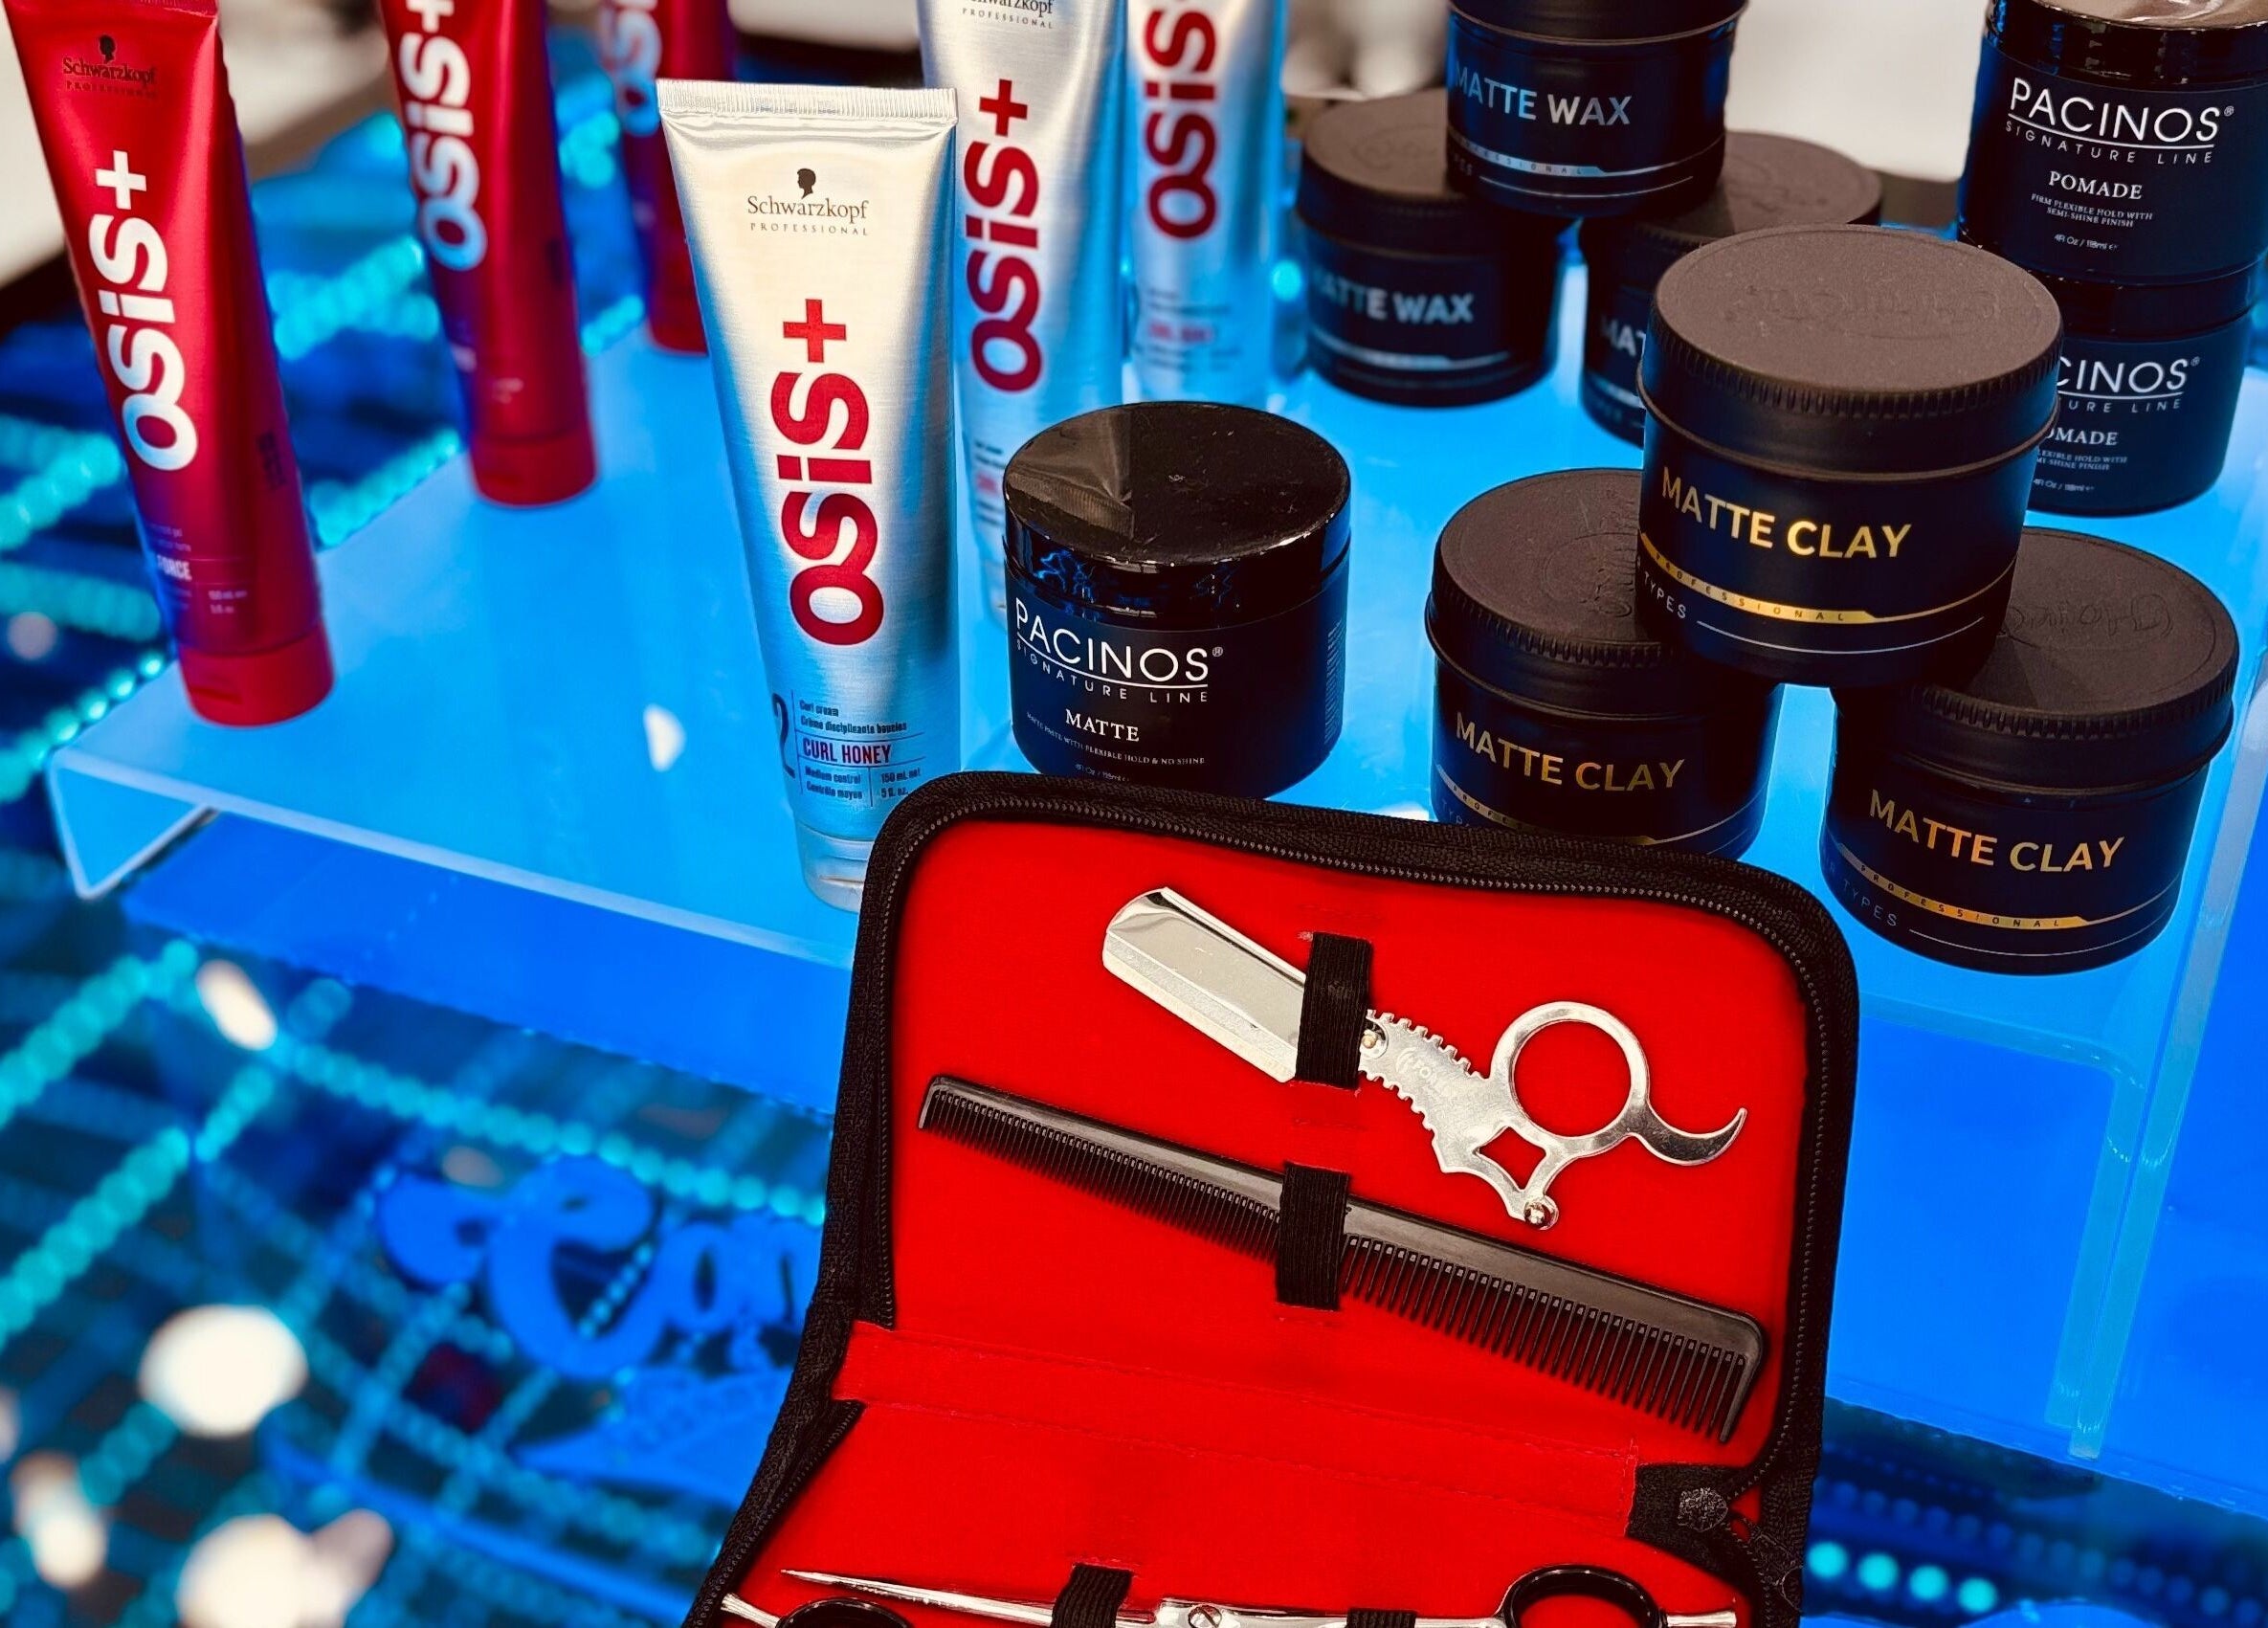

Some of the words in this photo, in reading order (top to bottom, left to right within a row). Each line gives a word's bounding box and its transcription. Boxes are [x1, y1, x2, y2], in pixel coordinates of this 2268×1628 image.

[962, 8, 1054, 29] PROFESSIONAL
[62, 56, 158, 90] Schwarzkopf
[1455, 60, 1538, 121] MATTE
[1547, 94, 1632, 125] WAX
[1143, 2, 1216, 240] OSiS
[2006, 121, 2136, 163] SIGNATURE
[2157, 151, 2212, 164] LINE
[2048, 170, 2143, 200] POMADE
[747, 195, 869, 224] Schwarzkopf
[2031, 192, 2052, 206] FIRM
[2054, 200, 2095, 214] FLEXIBLE
[2097, 209, 2124, 218] HOLD
[2126, 212, 2153, 220] WITH
[750, 222, 868, 235] PROFESSIONAL
[2101, 217, 2134, 228] FINISH
[1392, 292, 1475, 324] WAX
[2131, 398, 2182, 413] LINE
[2074, 455, 2101, 463] HOLD
[2102, 456, 2128, 464] WITH
[2079, 461, 2110, 471] FINISH
[1661, 466, 1775, 548] MATTE
[1787, 520, 1912, 559] CLAY
[1644, 570, 1687, 619] TYPES
[1655, 552, 1845, 621] PROFESSIONAL
[1016, 638, 1127, 700] SIGNATURE
[1149, 691, 1208, 703] LINE
[1065, 708, 1140, 742] MATTE
[802, 738, 838, 763] CURL
[842, 744, 892, 764] HONEY
[1085, 745, 1123, 760] FLEXIBLE
[1124, 754, 1150, 764] HOLD
[1456, 711, 1564, 785] MATTE
[1575, 759, 1685, 792] CLAY
[834, 773, 861, 785] control
[881, 772, 896, 784] 150
[1869, 789, 1998, 866] MATTE
[2010, 836, 2126, 872] CLAY
[1843, 879, 1898, 927] TYPES
[1860, 864, 2060, 928] PROFESSIONAL
